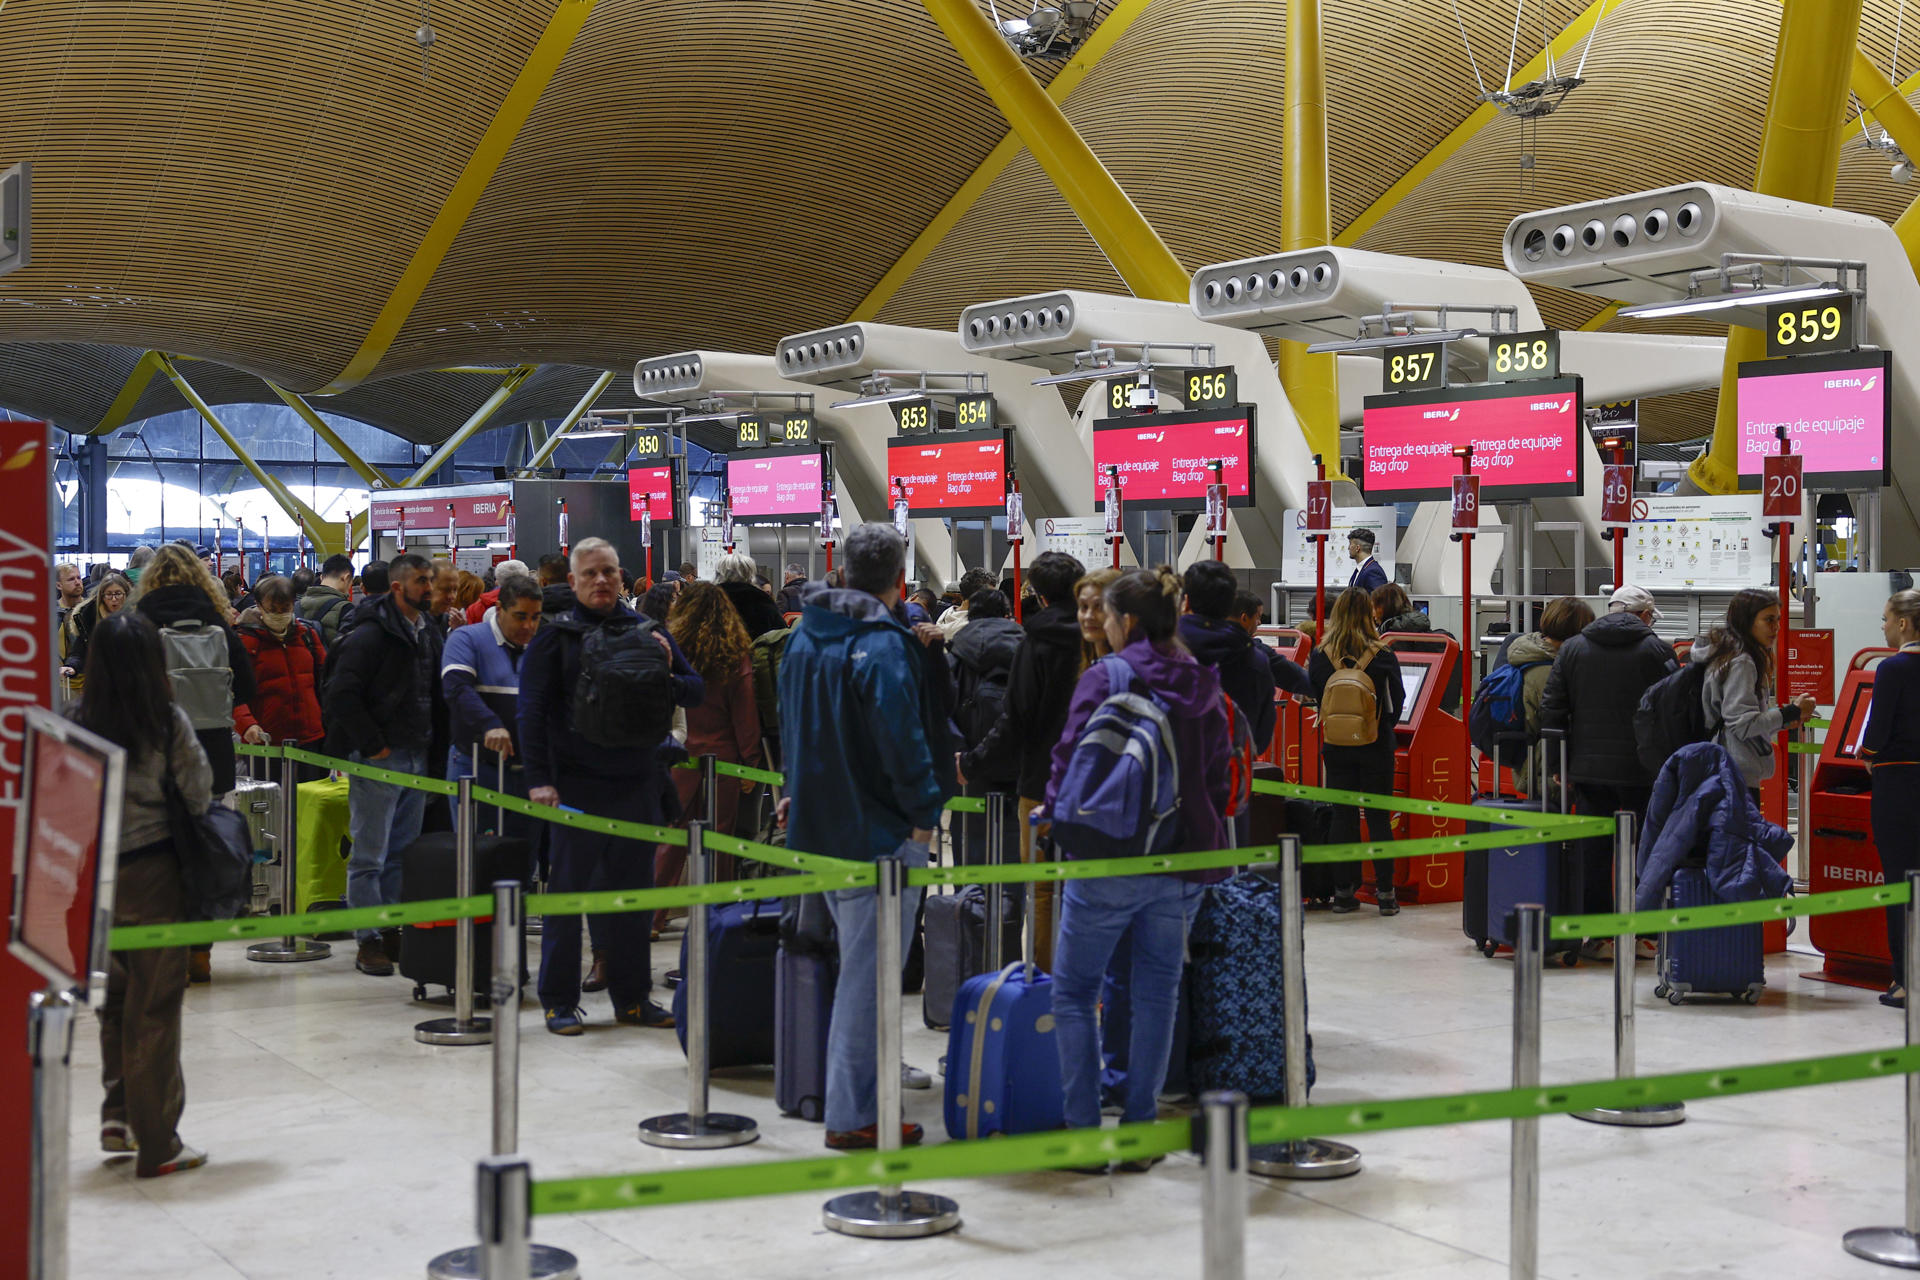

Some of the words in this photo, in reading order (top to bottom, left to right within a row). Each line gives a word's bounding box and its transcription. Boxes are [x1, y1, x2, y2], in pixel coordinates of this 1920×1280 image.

[1777, 306, 1840, 345] 859
[1495, 340, 1548, 372] 858
[1390, 352, 1434, 384] 857
[1190, 374, 1226, 401] 856
[1824, 378, 1862, 388] IBERIA
[1112, 383, 1139, 408] 85
[959, 400, 986, 424] 854
[1424, 410, 1450, 419] IBERIA
[1530, 402, 1559, 411] IBERIA
[901, 406, 927, 428] 853
[1794, 418, 1810, 432] de
[1812, 416, 1865, 435] equipaje
[740, 422, 759, 442] 851
[786, 419, 808, 440] 852
[638, 435, 658, 454] 850
[1370, 444, 1402, 459] Entrega
[1403, 443, 1414, 456] de
[1416, 441, 1452, 456] equipaje
[1471, 439, 1506, 455] Entrega
[1507, 437, 1520, 450] de
[1521, 434, 1562, 449] equipaje
[1746, 439, 1770, 455] Bag
[1772, 439, 1802, 454] dp
[1123, 461, 1132, 472] de
[1132, 459, 1159, 473] equipaje
[1172, 458, 1198, 471] Entrega
[1199, 456, 1208, 468] de
[1369, 460, 1386, 475] Bag
[1387, 459, 1409, 473] drop
[1471, 455, 1489, 469] Bag
[1491, 454, 1514, 468] drop
[917, 473, 938, 484] equipaje
[947, 472, 967, 484] Entrega
[967, 470, 974, 480] de
[975, 470, 997, 481] equipaje
[1098, 475, 1112, 487] Bag
[1172, 472, 1186, 484] Bag
[1187, 471, 1204, 483] drop
[1770, 476, 1796, 496] 20
[947, 484, 958, 495] Bag
[958, 483, 971, 494] drop
[1607, 484, 1627, 504] 19
[473, 503, 497, 514] IBERIA
[1210, 500, 1224, 516] 16
[1310, 497, 1328, 514] 17
[1456, 493, 1475, 511] 18
[1824, 865, 1885, 884] IBERIA
